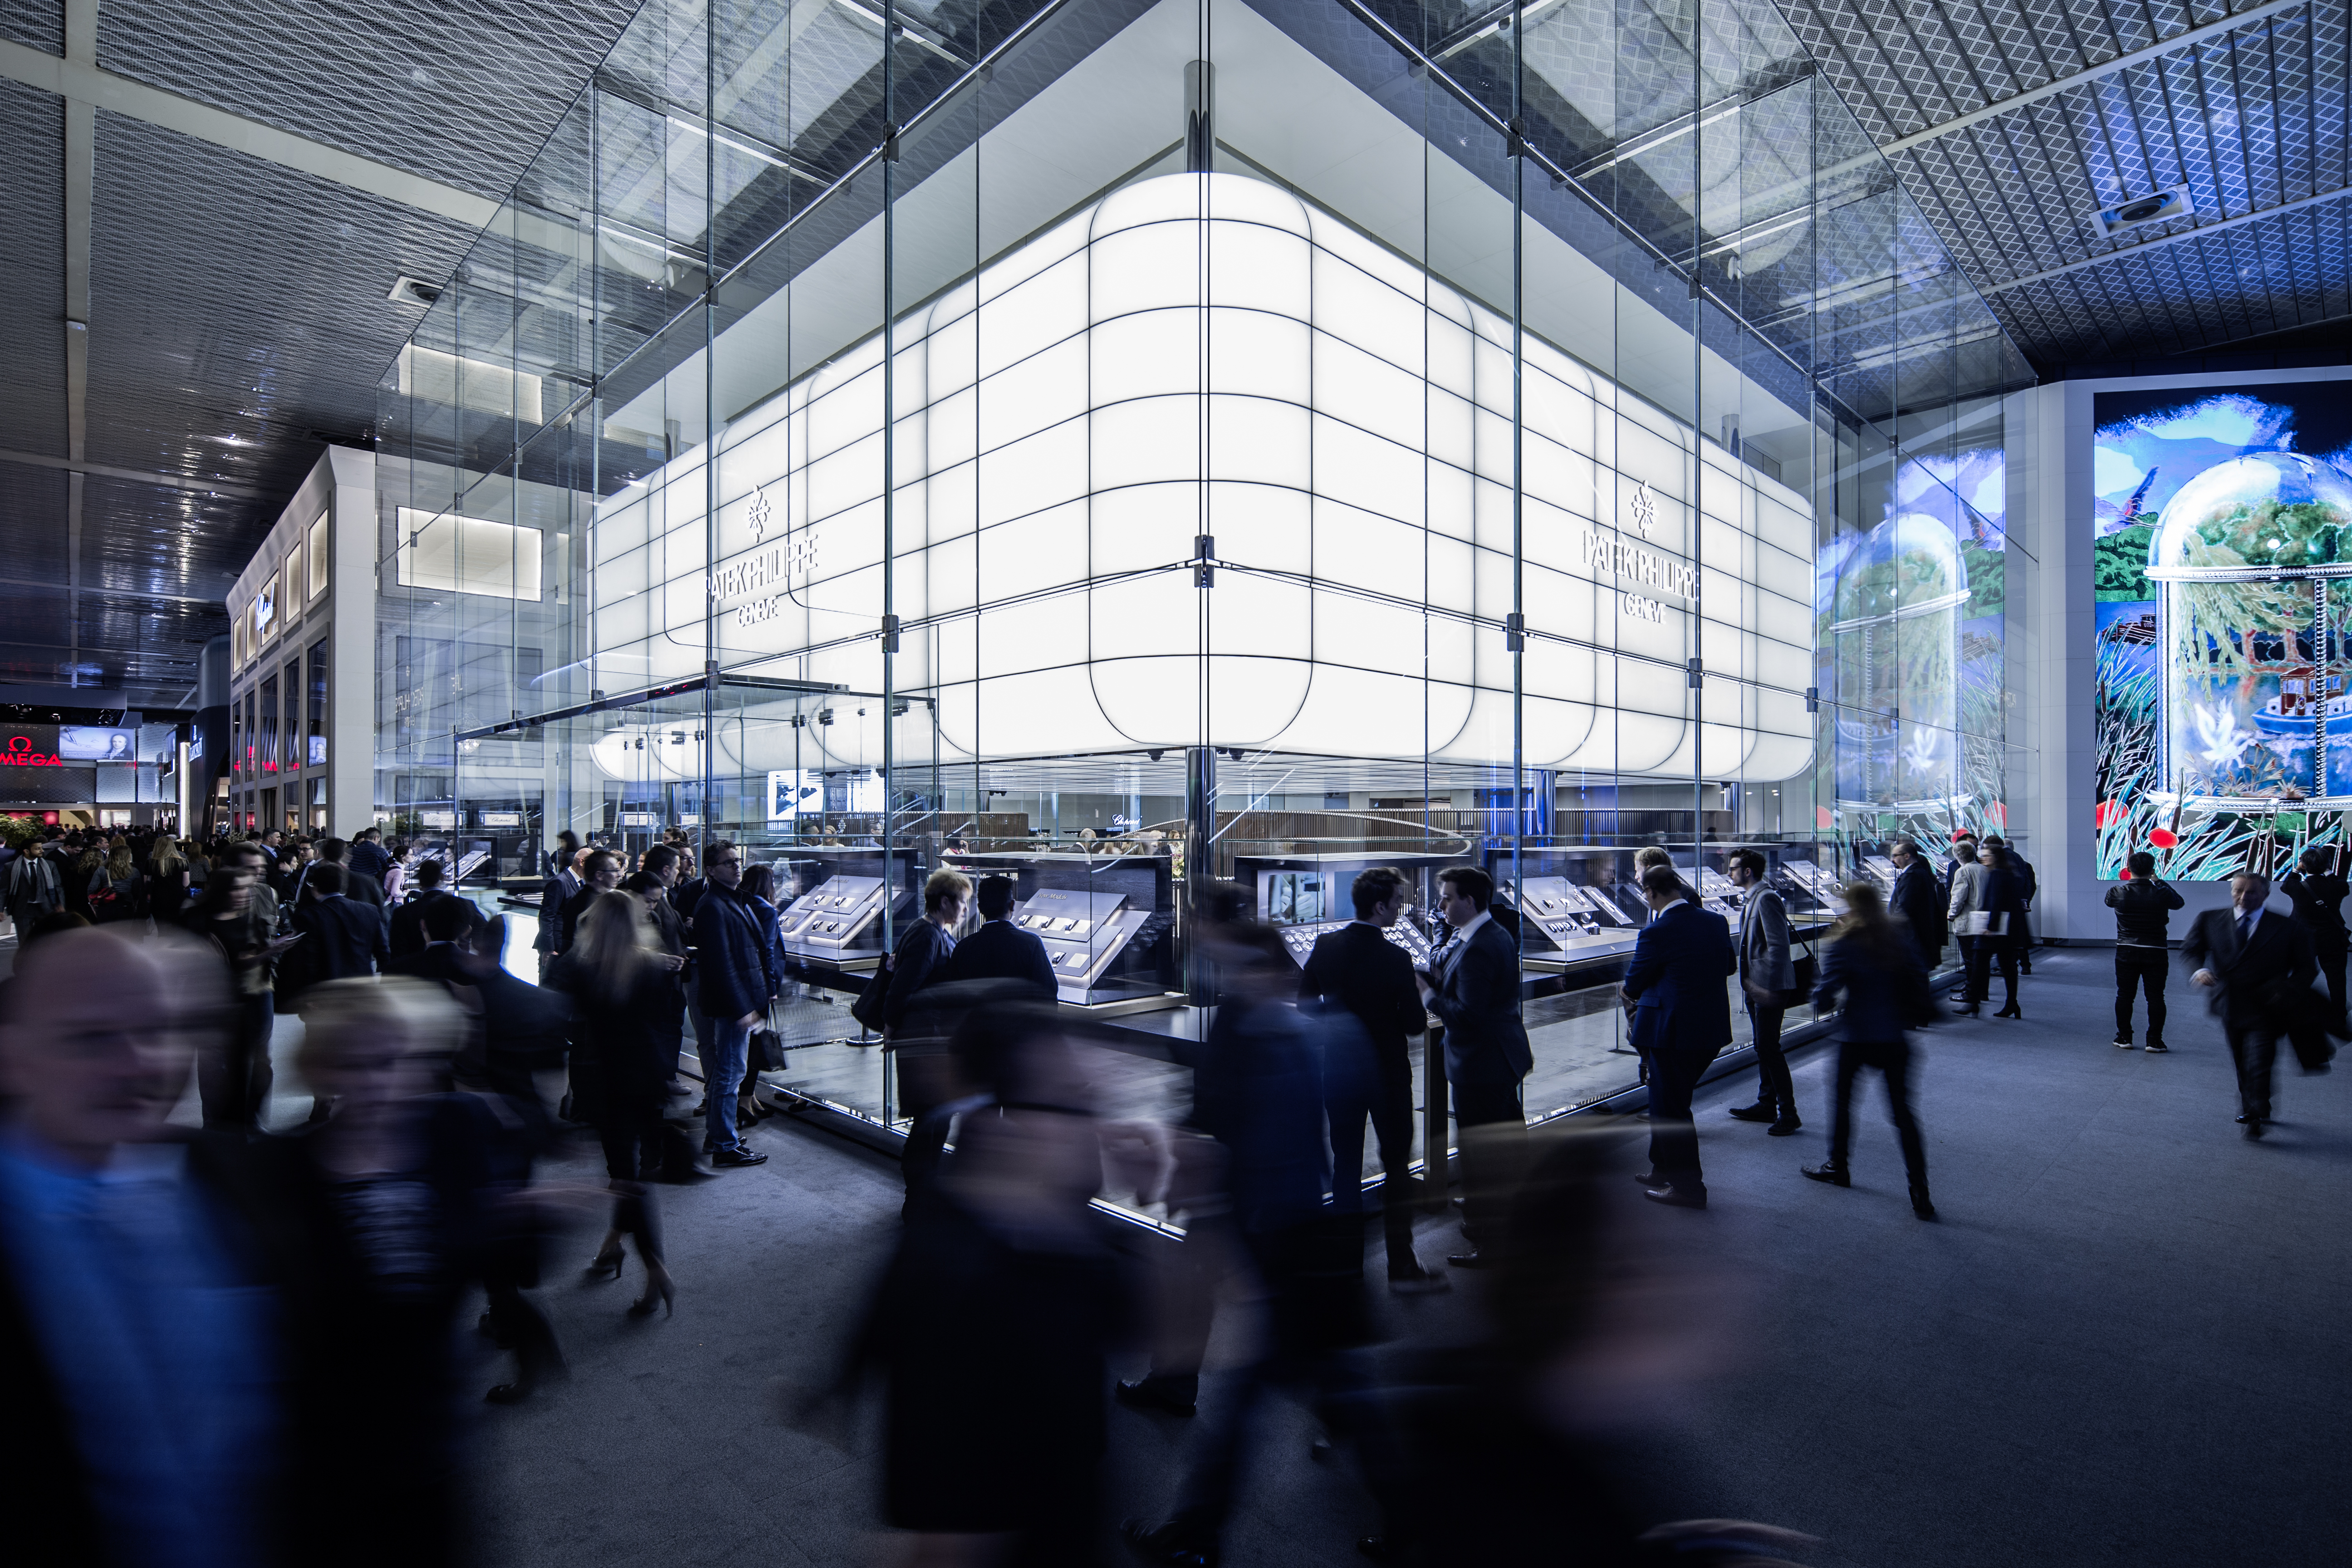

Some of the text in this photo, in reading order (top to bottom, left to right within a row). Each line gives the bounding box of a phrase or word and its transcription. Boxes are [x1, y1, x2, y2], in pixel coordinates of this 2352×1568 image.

[705, 534, 818, 605] PATEK PHILIPPE
[1583, 530, 1635, 580] PATEK
[735, 595, 779, 627] GENEVE
[1624, 593, 1667, 625] GENEVE
[0, 753, 63, 767] MEGA
